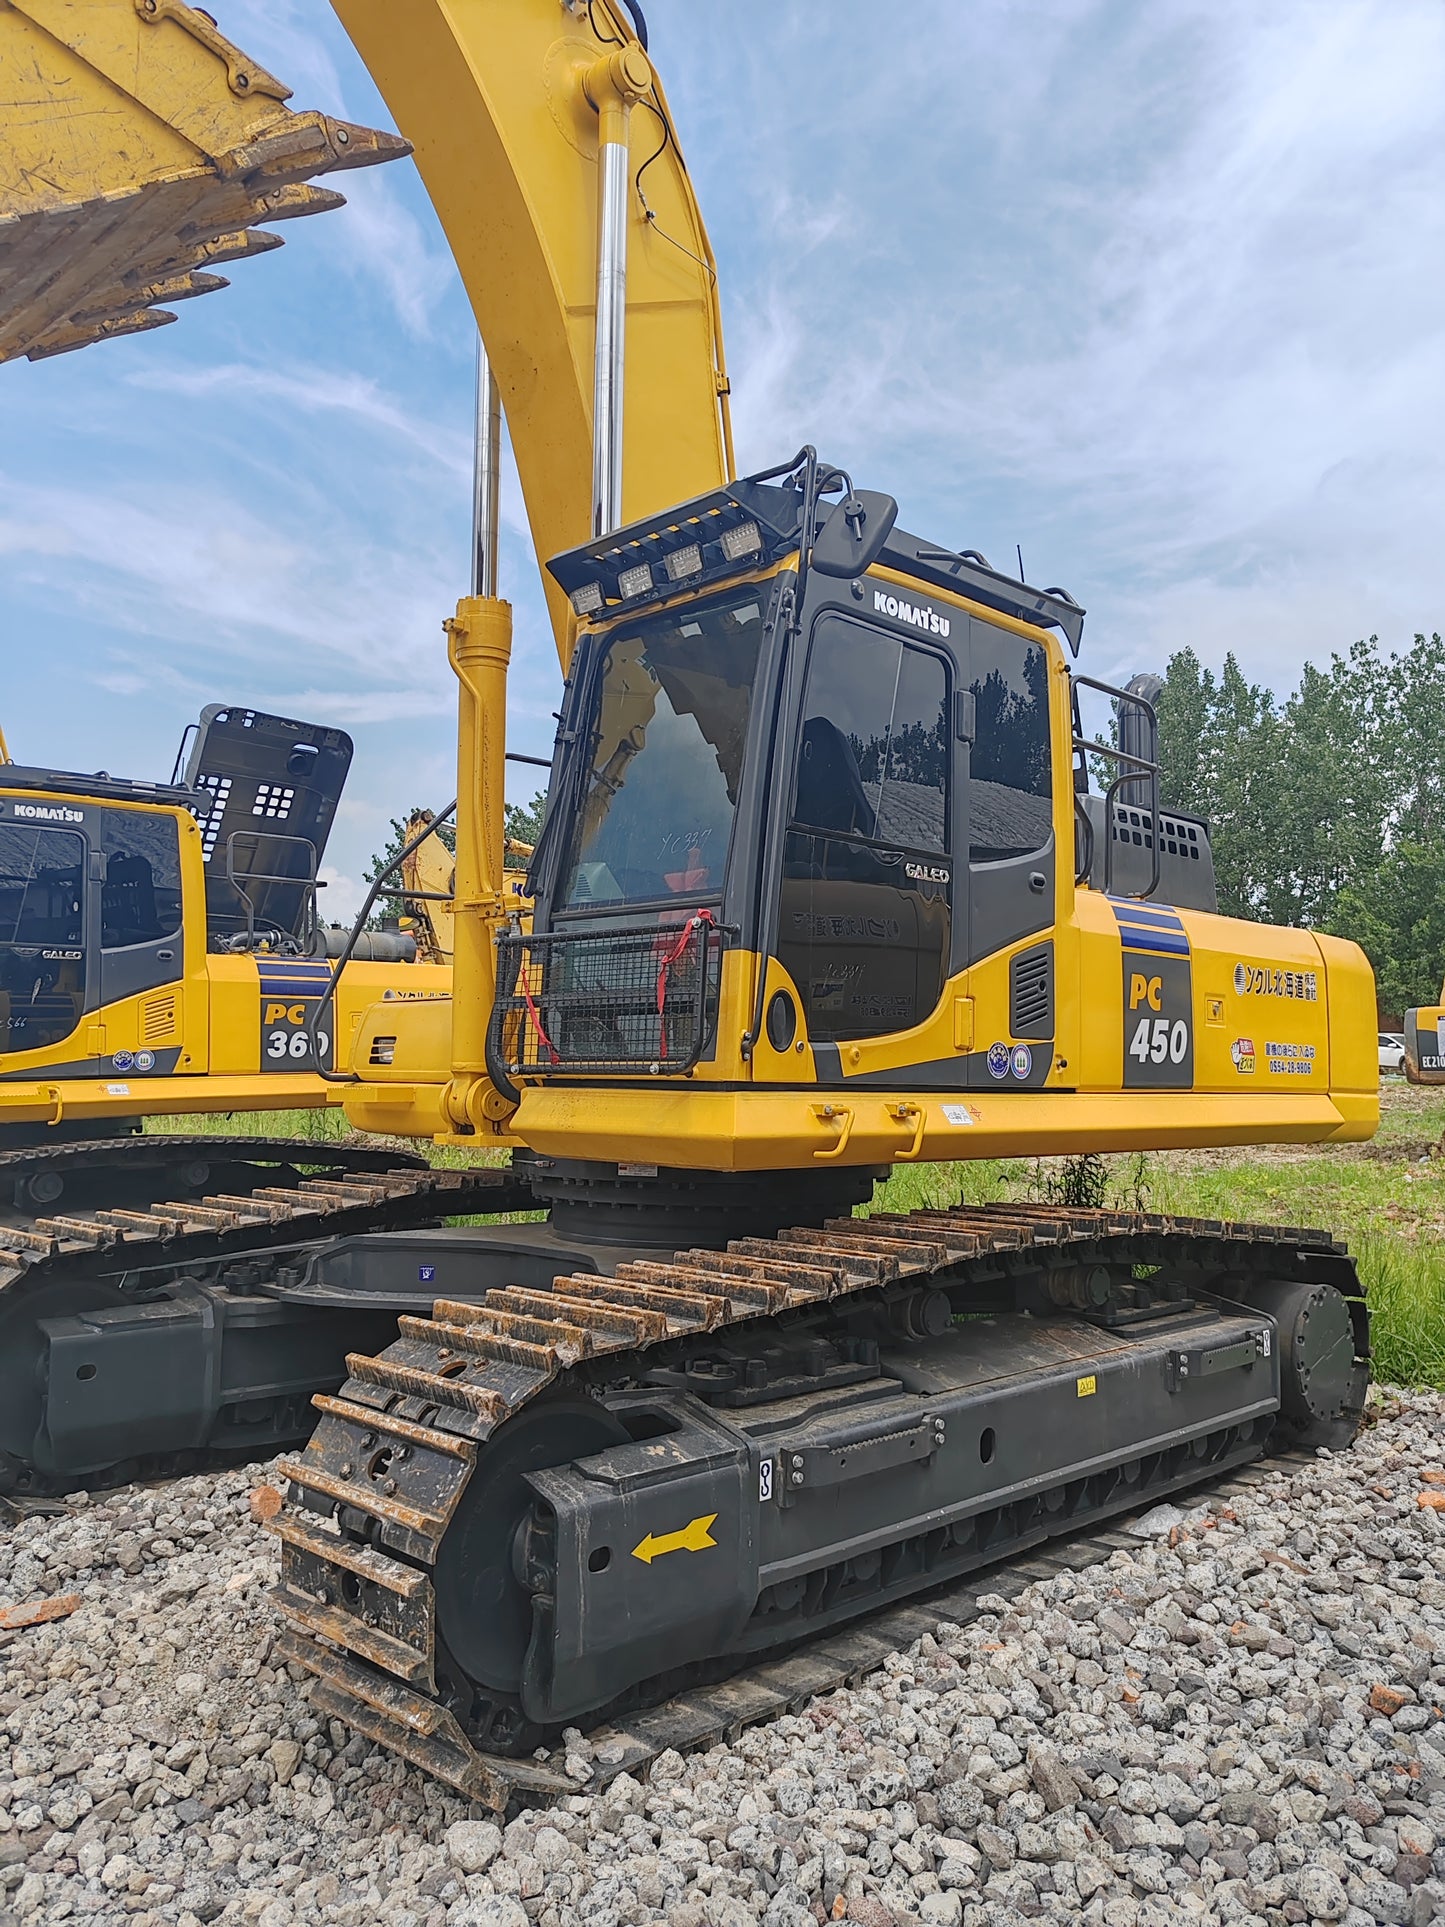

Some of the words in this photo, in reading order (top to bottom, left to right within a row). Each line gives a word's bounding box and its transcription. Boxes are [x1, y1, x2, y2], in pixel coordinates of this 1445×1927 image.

[874, 590, 950, 637] KOMATSU
[14, 804, 84, 823] KOMATSU
[905, 863, 950, 884] GALEO
[42, 950, 83, 960] GALEO
[1129, 973, 1162, 1012] PC
[264, 1003, 306, 1025] PC
[267, 1030, 329, 1059] 360
[1129, 1018, 1188, 1064] 450
